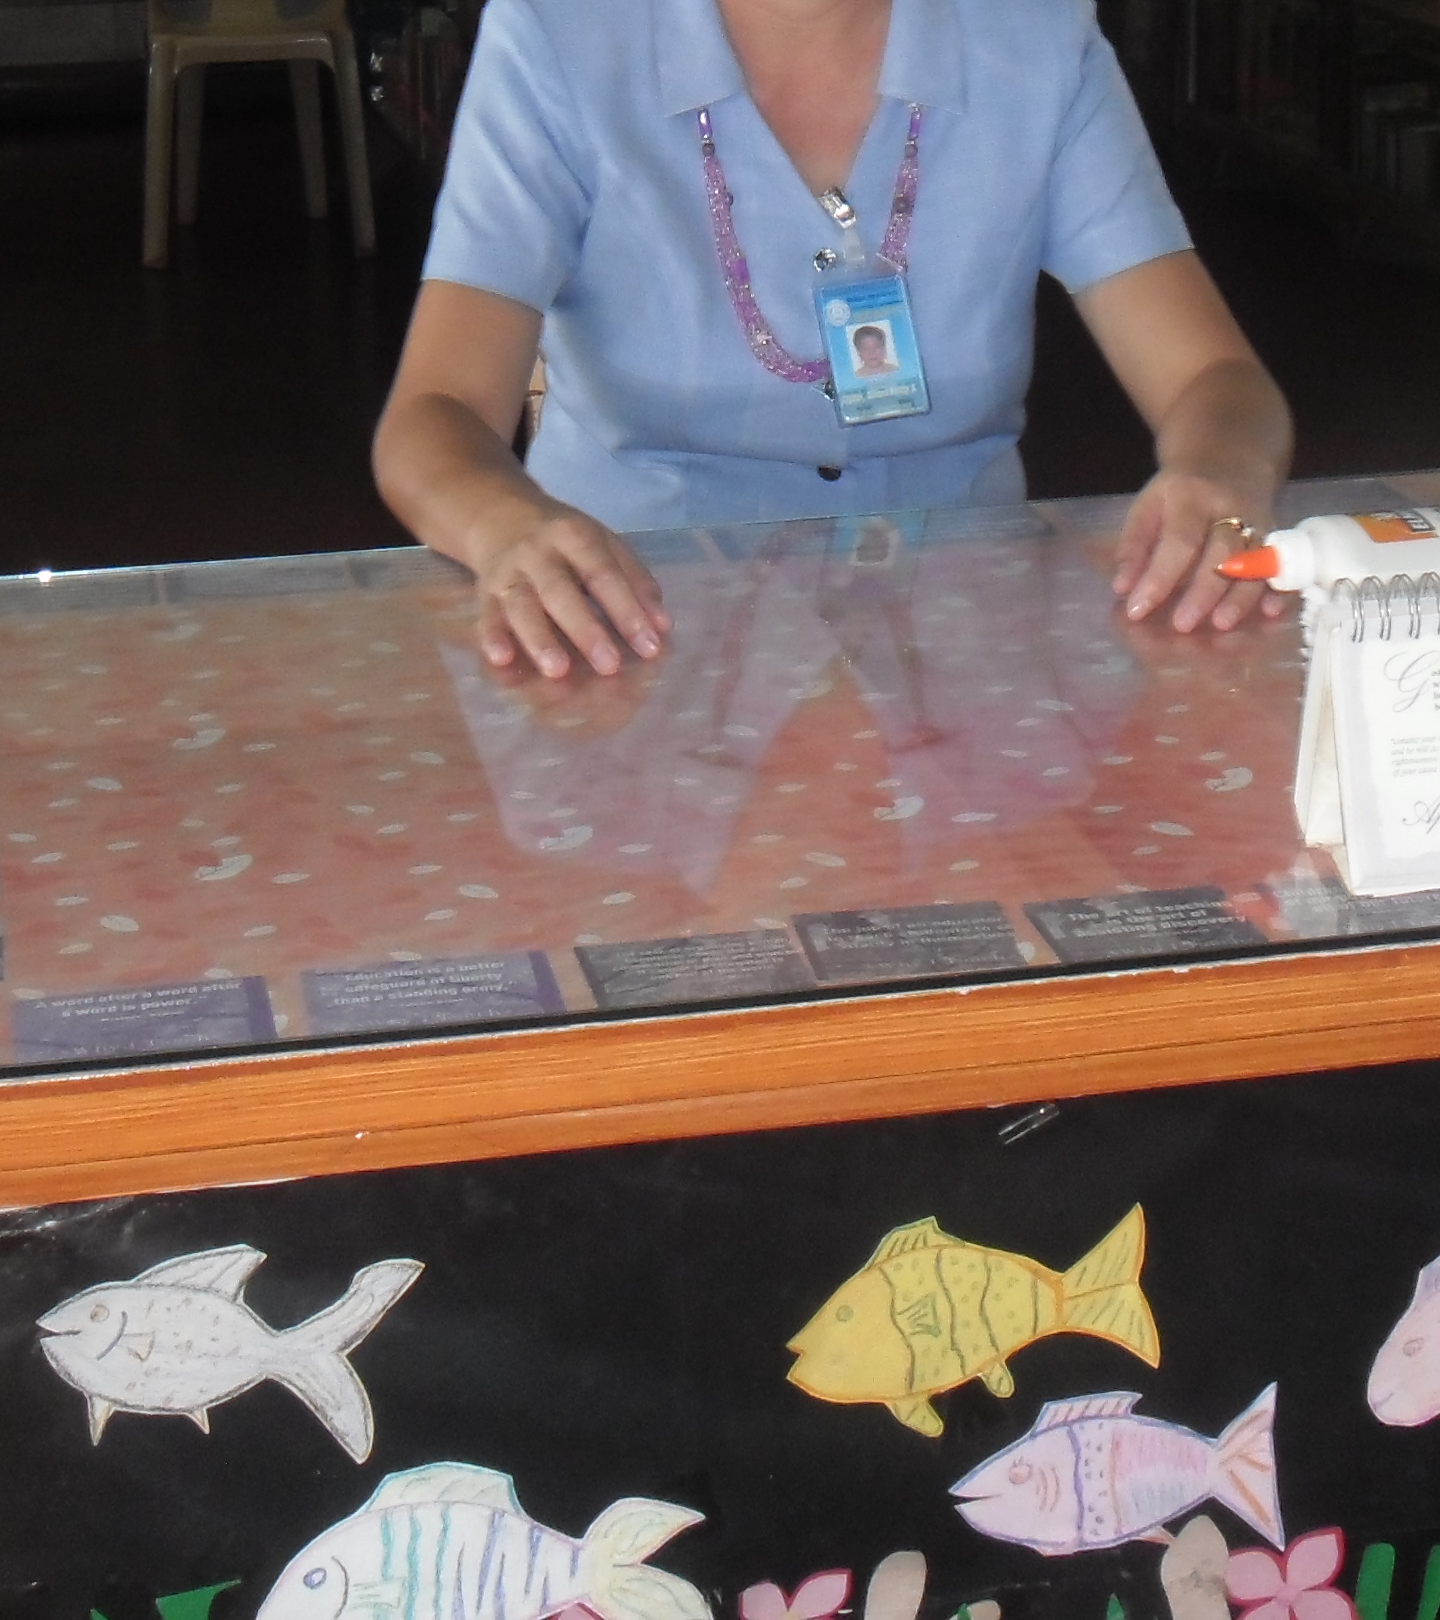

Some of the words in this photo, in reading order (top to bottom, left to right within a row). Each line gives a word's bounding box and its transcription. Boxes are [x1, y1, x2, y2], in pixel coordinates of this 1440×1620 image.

[51, 996, 94, 1008] word
[156, 985, 199, 997] word
[75, 1005, 117, 1016] word
